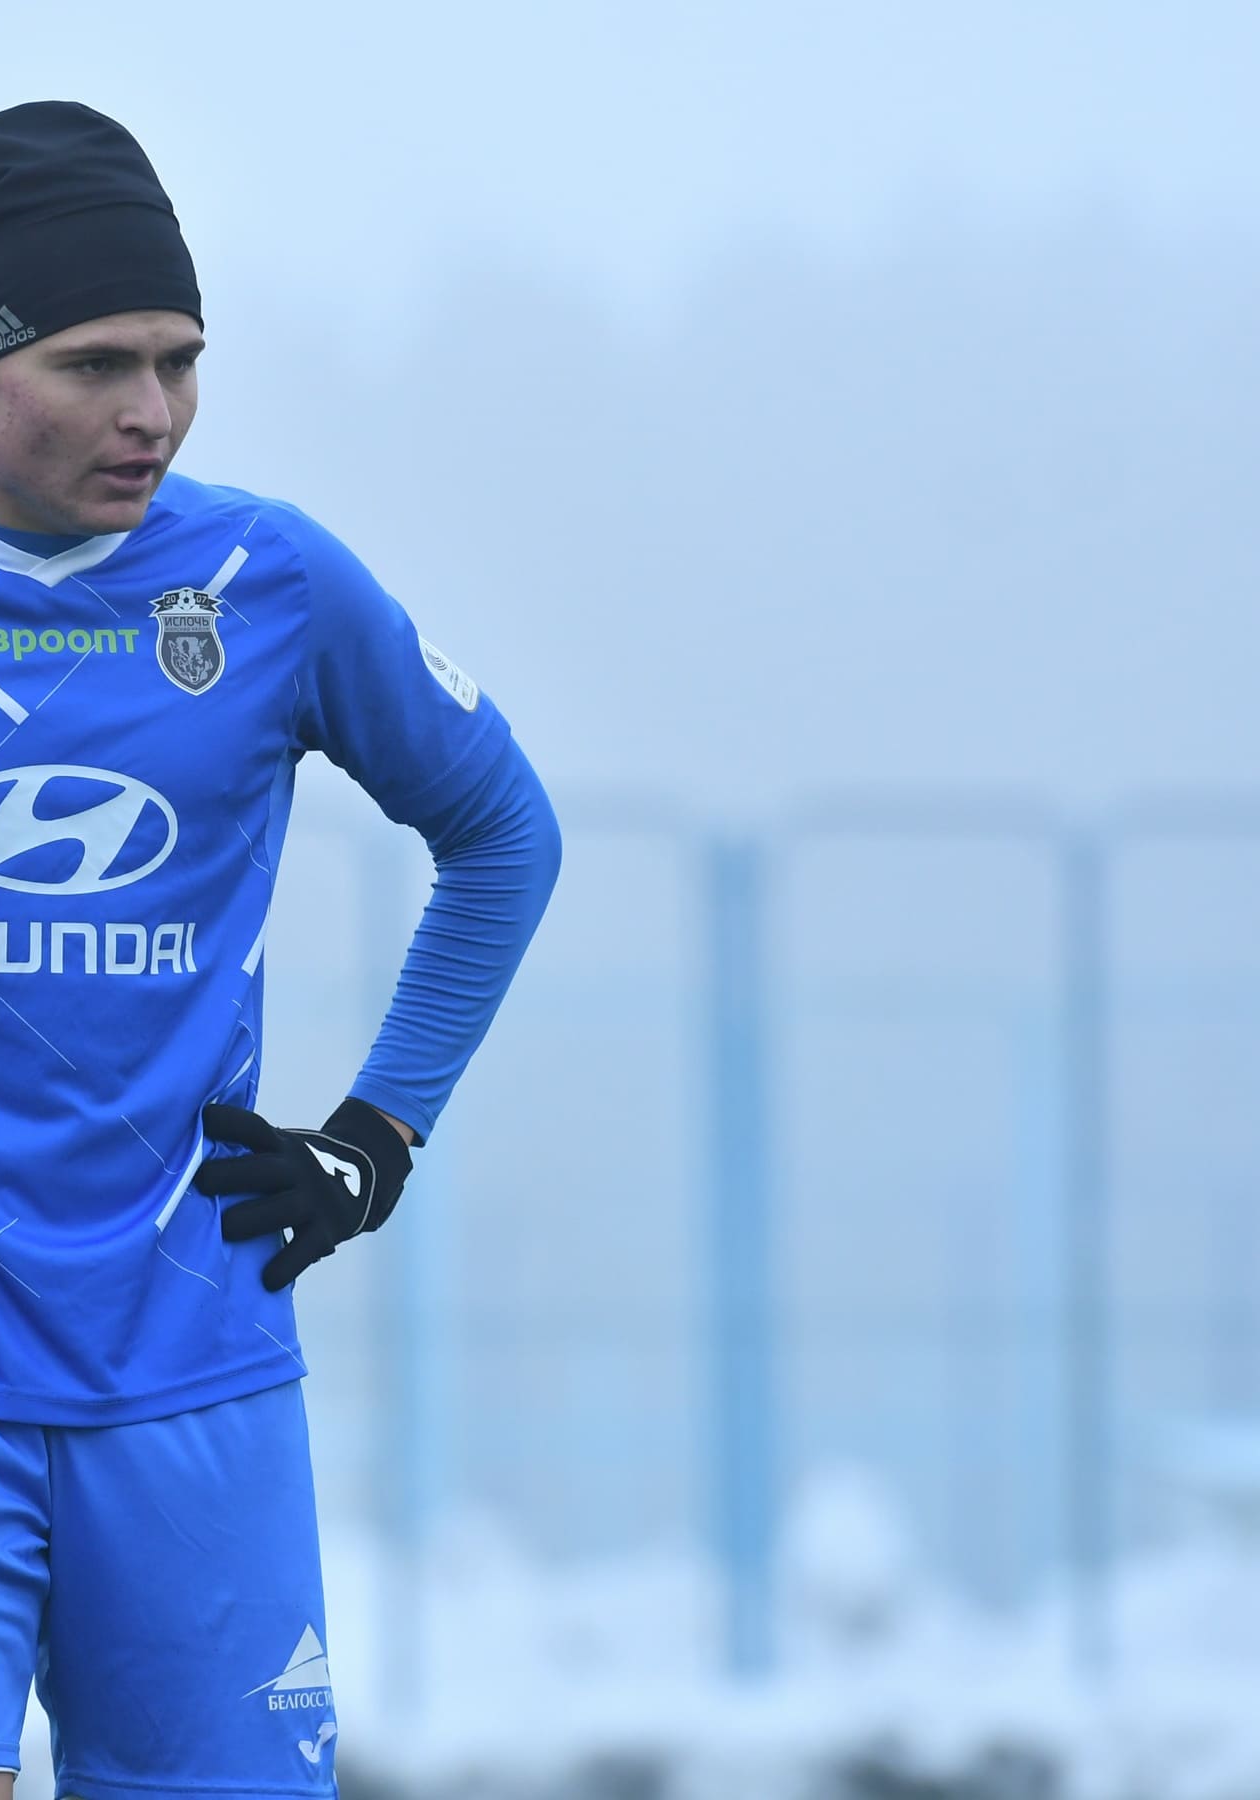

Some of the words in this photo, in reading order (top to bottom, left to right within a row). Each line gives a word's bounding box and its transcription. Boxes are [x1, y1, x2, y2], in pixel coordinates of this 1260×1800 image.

[165, 594, 177, 604] 20
[196, 594, 207, 604] 07
[164, 616, 209, 627] ИСЛОЧЬ
